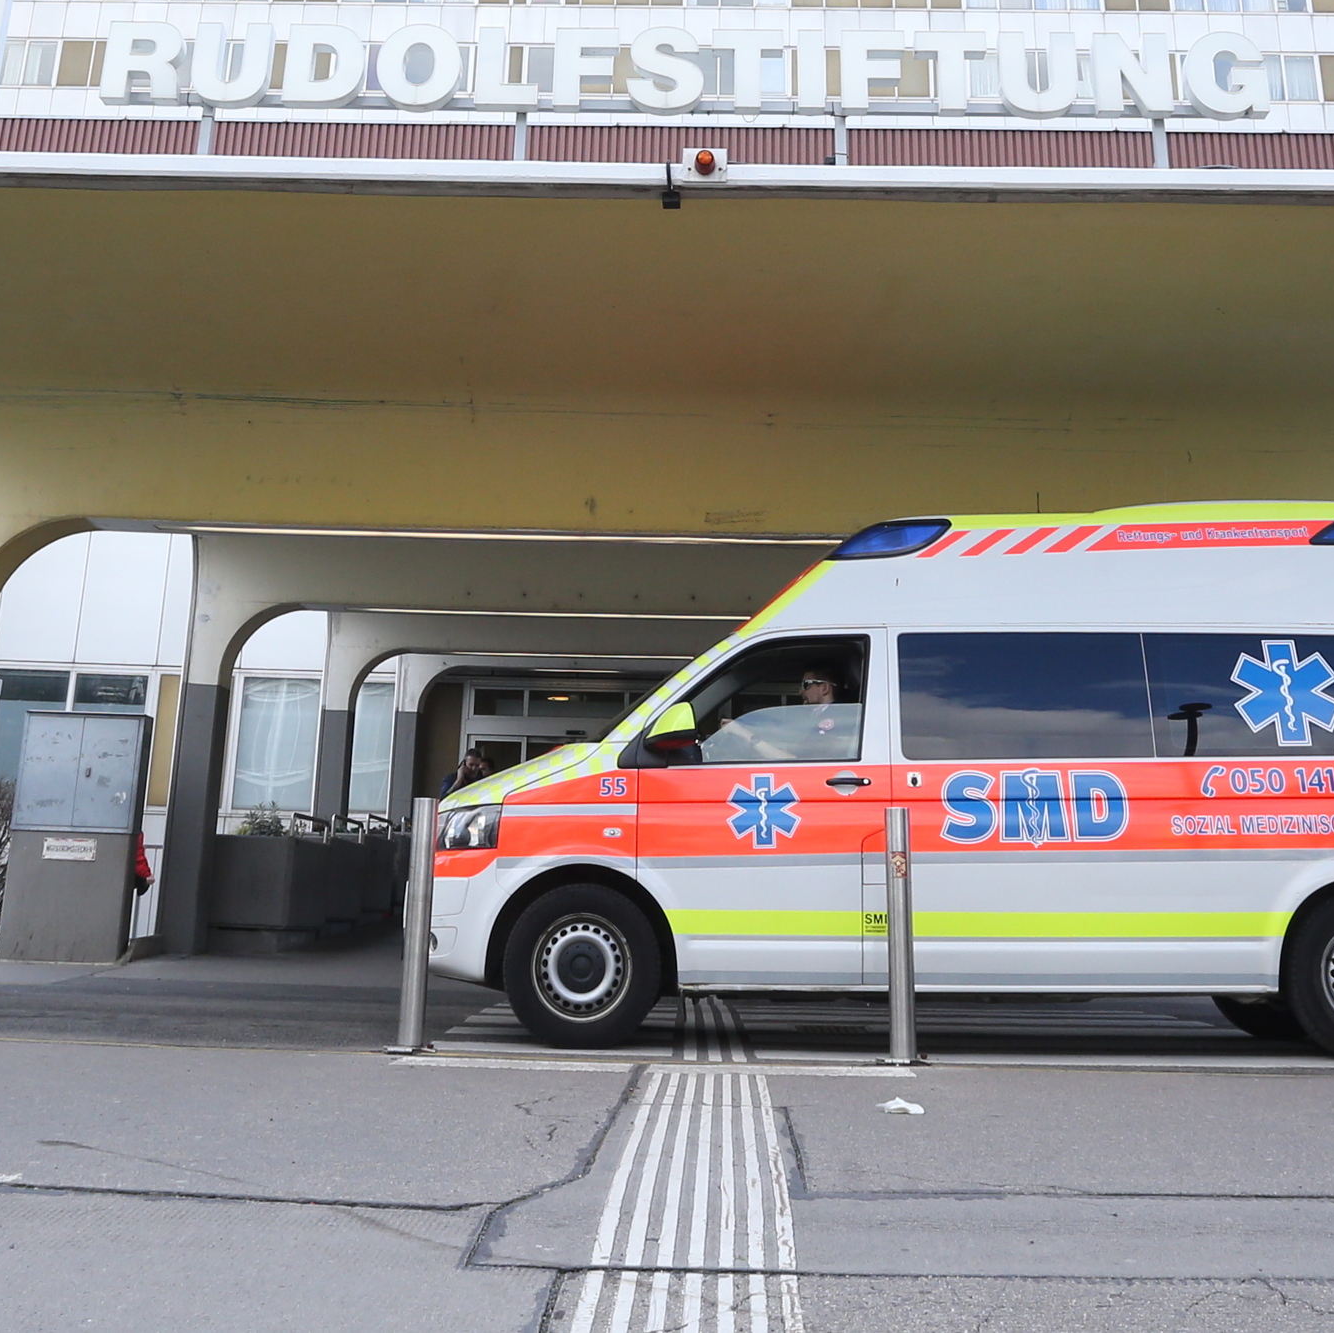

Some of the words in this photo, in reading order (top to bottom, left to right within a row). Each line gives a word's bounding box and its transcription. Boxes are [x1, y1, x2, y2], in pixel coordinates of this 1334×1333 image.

[99, 21, 1270, 120] RUDOLFSTIFTUNG
[1117, 530, 1177, 543] Rettungs-
[1181, 528, 1202, 541] und
[1206, 527, 1309, 541] Krankentransport
[599, 776, 628, 798] 55
[1229, 767, 1286, 794] 050
[939, 769, 1130, 845] SMD
[1170, 814, 1237, 835] SOZIAL
[864, 913, 888, 925] SM
